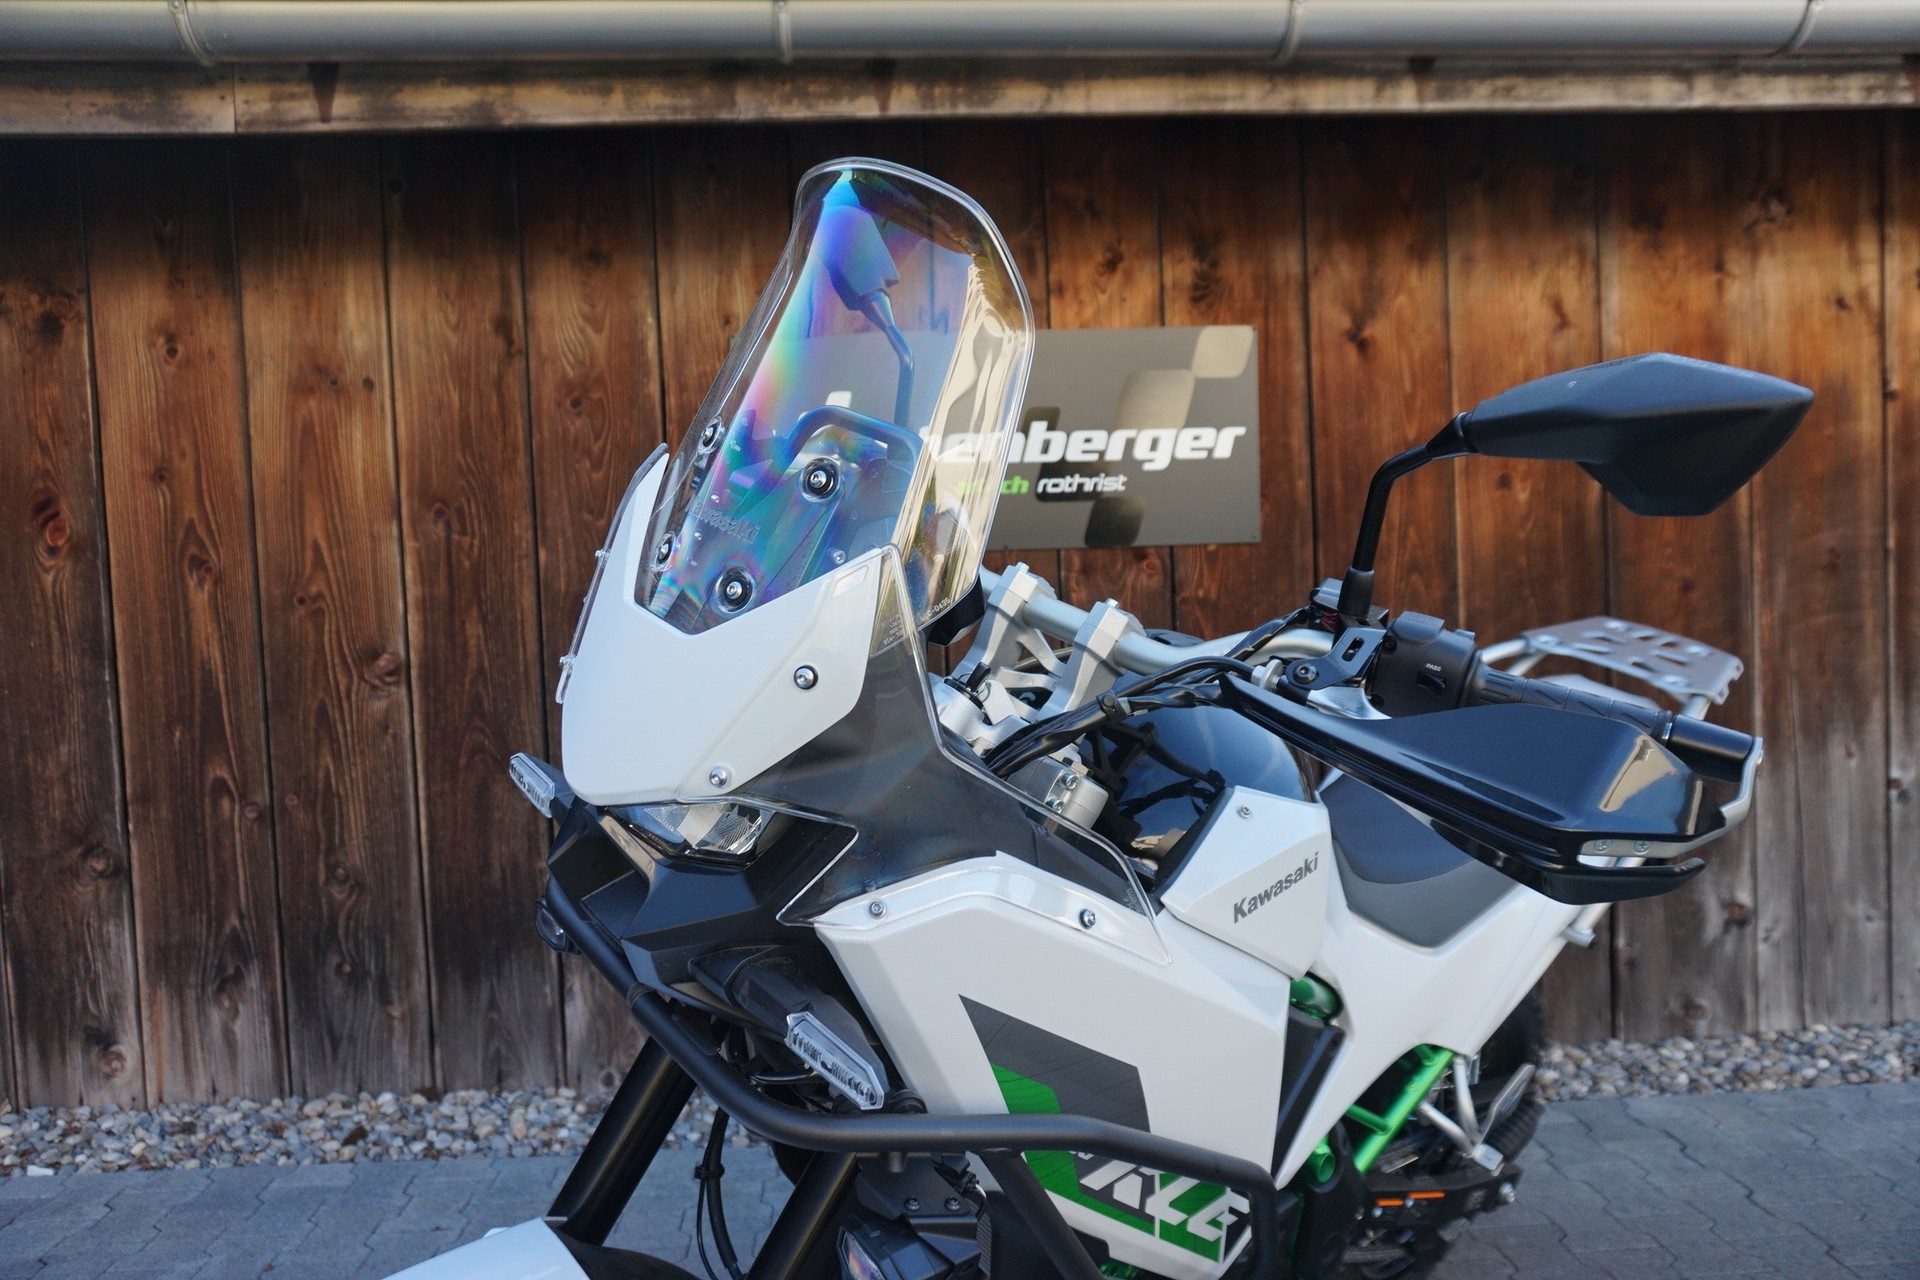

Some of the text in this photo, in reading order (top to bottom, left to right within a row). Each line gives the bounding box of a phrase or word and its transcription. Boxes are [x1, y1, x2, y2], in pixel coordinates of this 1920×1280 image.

[1036, 473, 1128, 494] rothrist
[1425, 662, 1442, 672] PASS
[1233, 851, 1319, 924] Kawasaki
